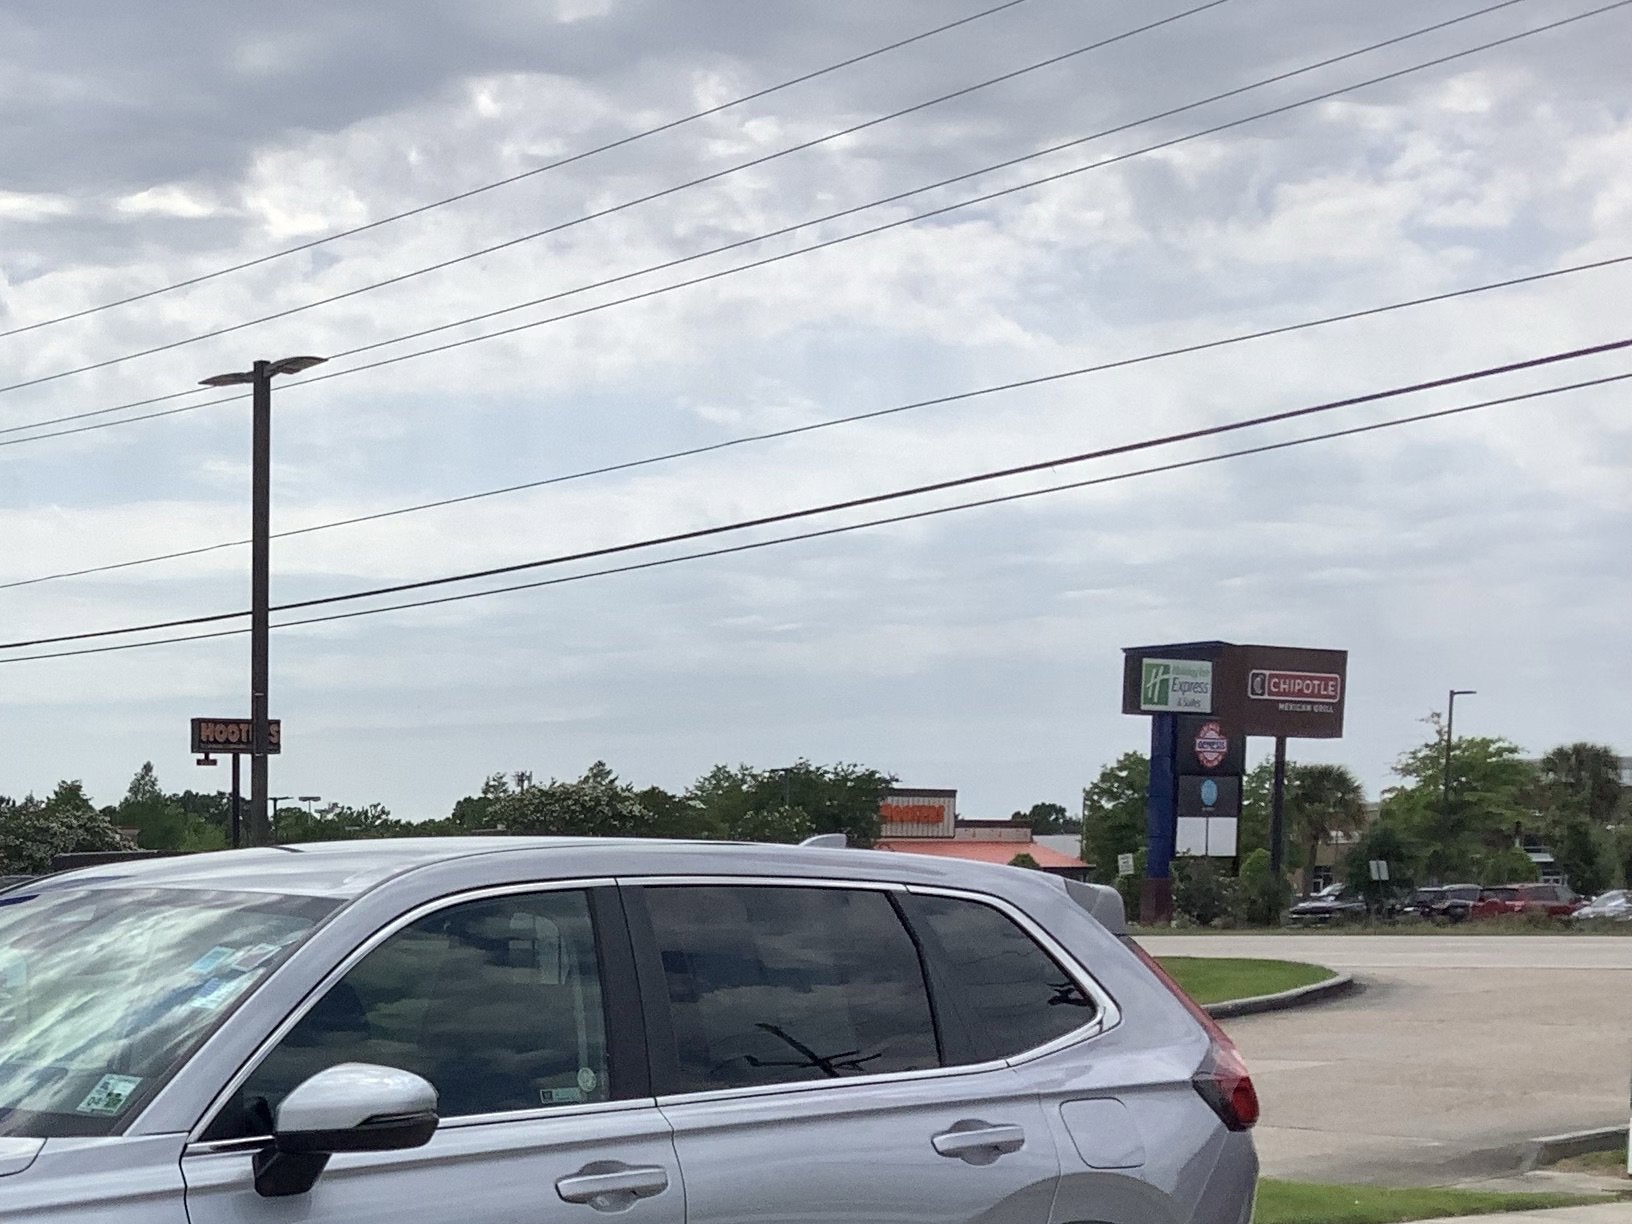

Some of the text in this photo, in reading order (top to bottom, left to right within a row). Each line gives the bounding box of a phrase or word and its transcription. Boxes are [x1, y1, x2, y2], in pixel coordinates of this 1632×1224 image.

[1172, 677, 1208, 695] Express
[1270, 679, 1337, 696] CHIPOTLE
[1279, 703, 1313, 712] MEXICAN
[200, 723, 280, 743] HOOTS
